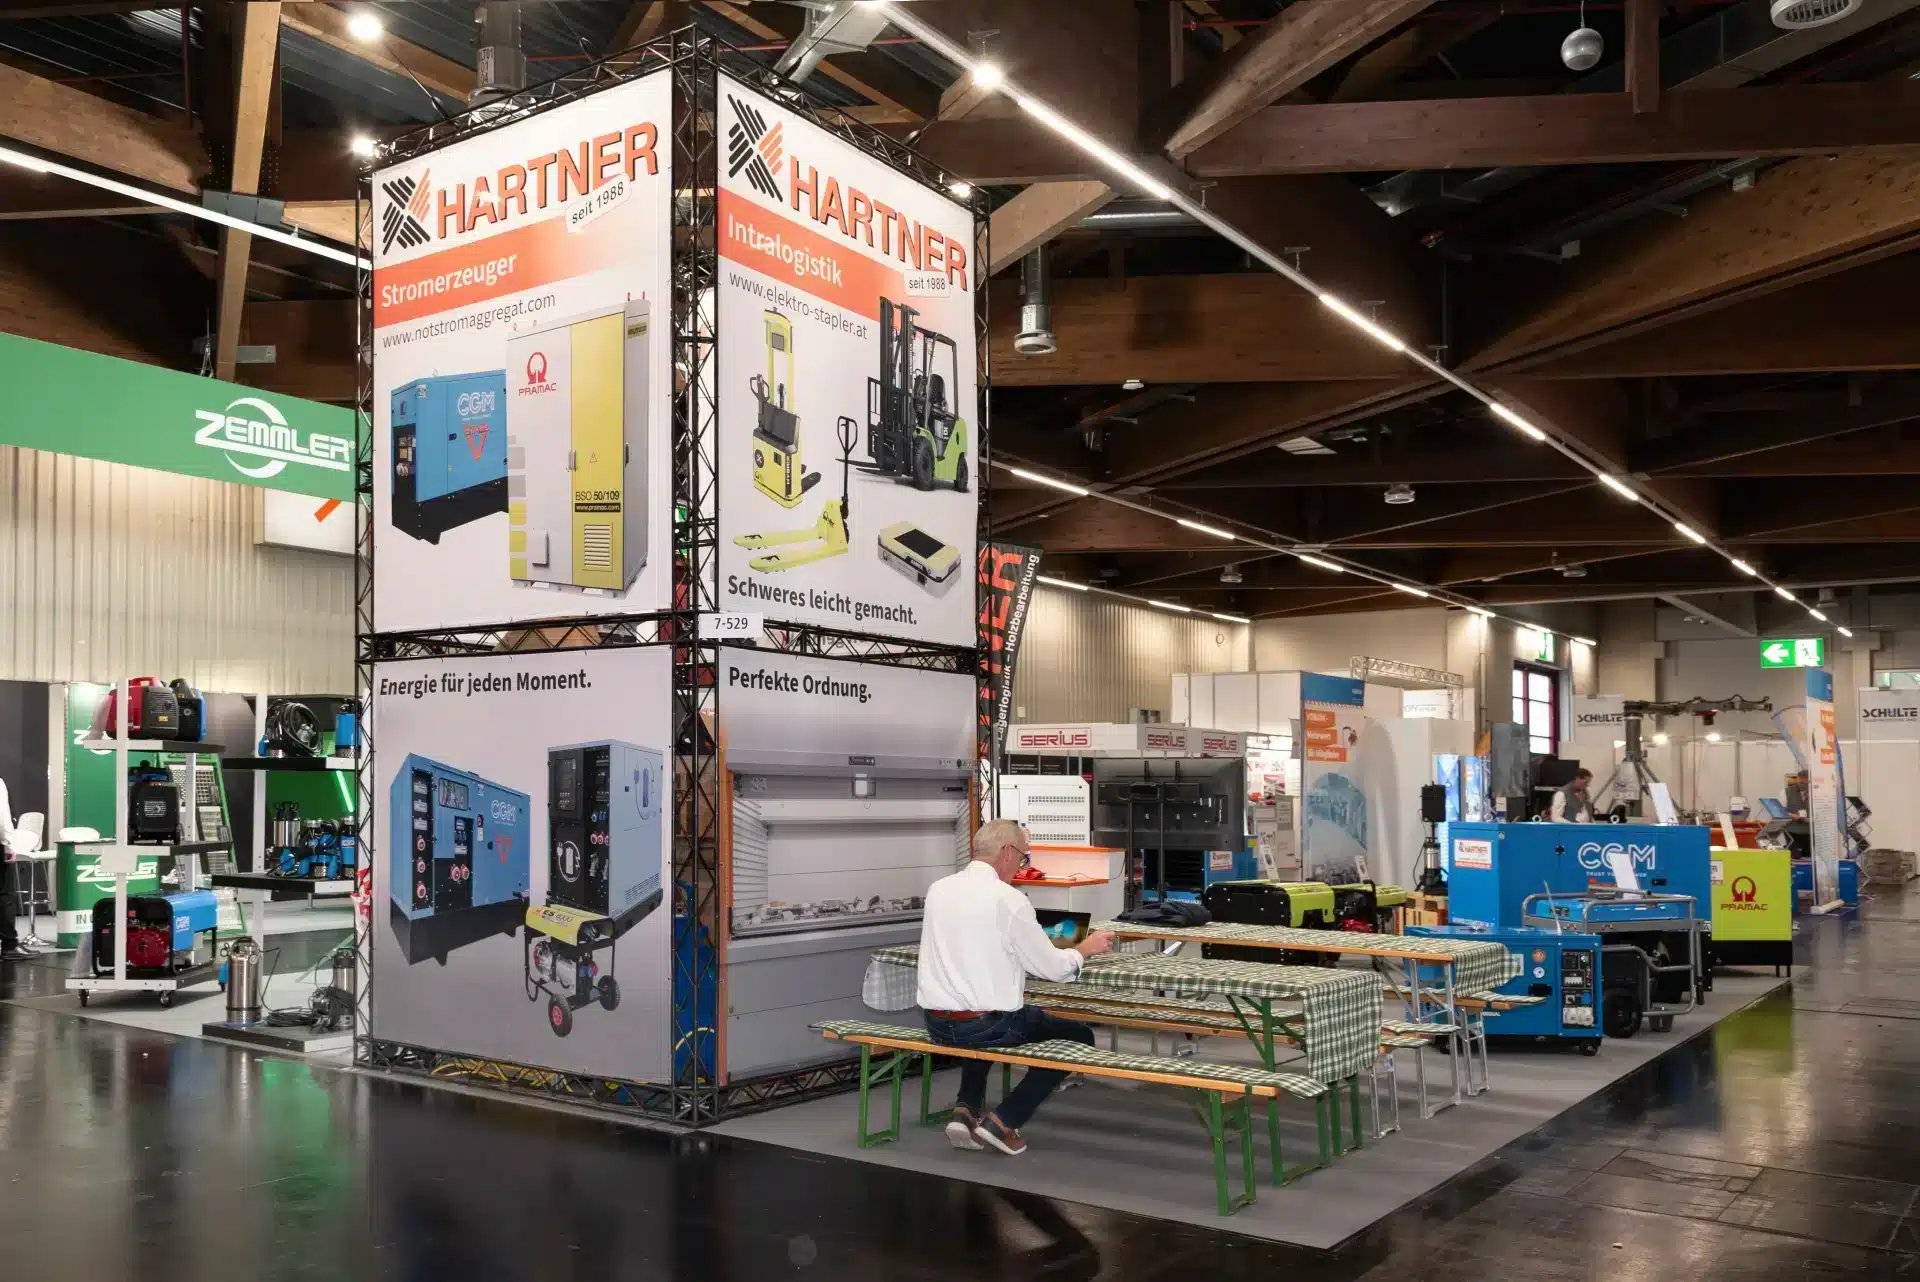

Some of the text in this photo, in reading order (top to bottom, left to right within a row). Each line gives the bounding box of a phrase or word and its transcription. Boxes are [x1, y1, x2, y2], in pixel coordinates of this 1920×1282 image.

[437, 121, 659, 239] HARTNER
[572, 181, 624, 225] seit 1988
[790, 154, 968, 292] HARTNER
[728, 212, 843, 288] Intralogistik
[381, 252, 518, 308] Stromerzeuger
[908, 276, 946, 290] seit 1988
[382, 292, 556, 349] www.notstromaggregat.com
[729, 271, 868, 340] www.elektro-stapler.at
[458, 391, 494, 416] CGM
[518, 382, 556, 396] PRAMAC
[195, 410, 350, 472] ZEMMLER
[594, 490, 620, 500] 50/109
[728, 574, 918, 625] Schweres leicht gemacht.
[1005, 554, 1040, 652] Holzbearbeitung
[714, 617, 748, 630] 7-529
[380, 669, 592, 699] Energie für jeden Moment.
[729, 666, 872, 703] Perfekte Ordnung.
[1576, 713, 1623, 723] SCHULTE
[1862, 707, 1918, 718] SCHULTE
[491, 799, 516, 822] CGM
[1720, 904, 1768, 912] PRAMAC
